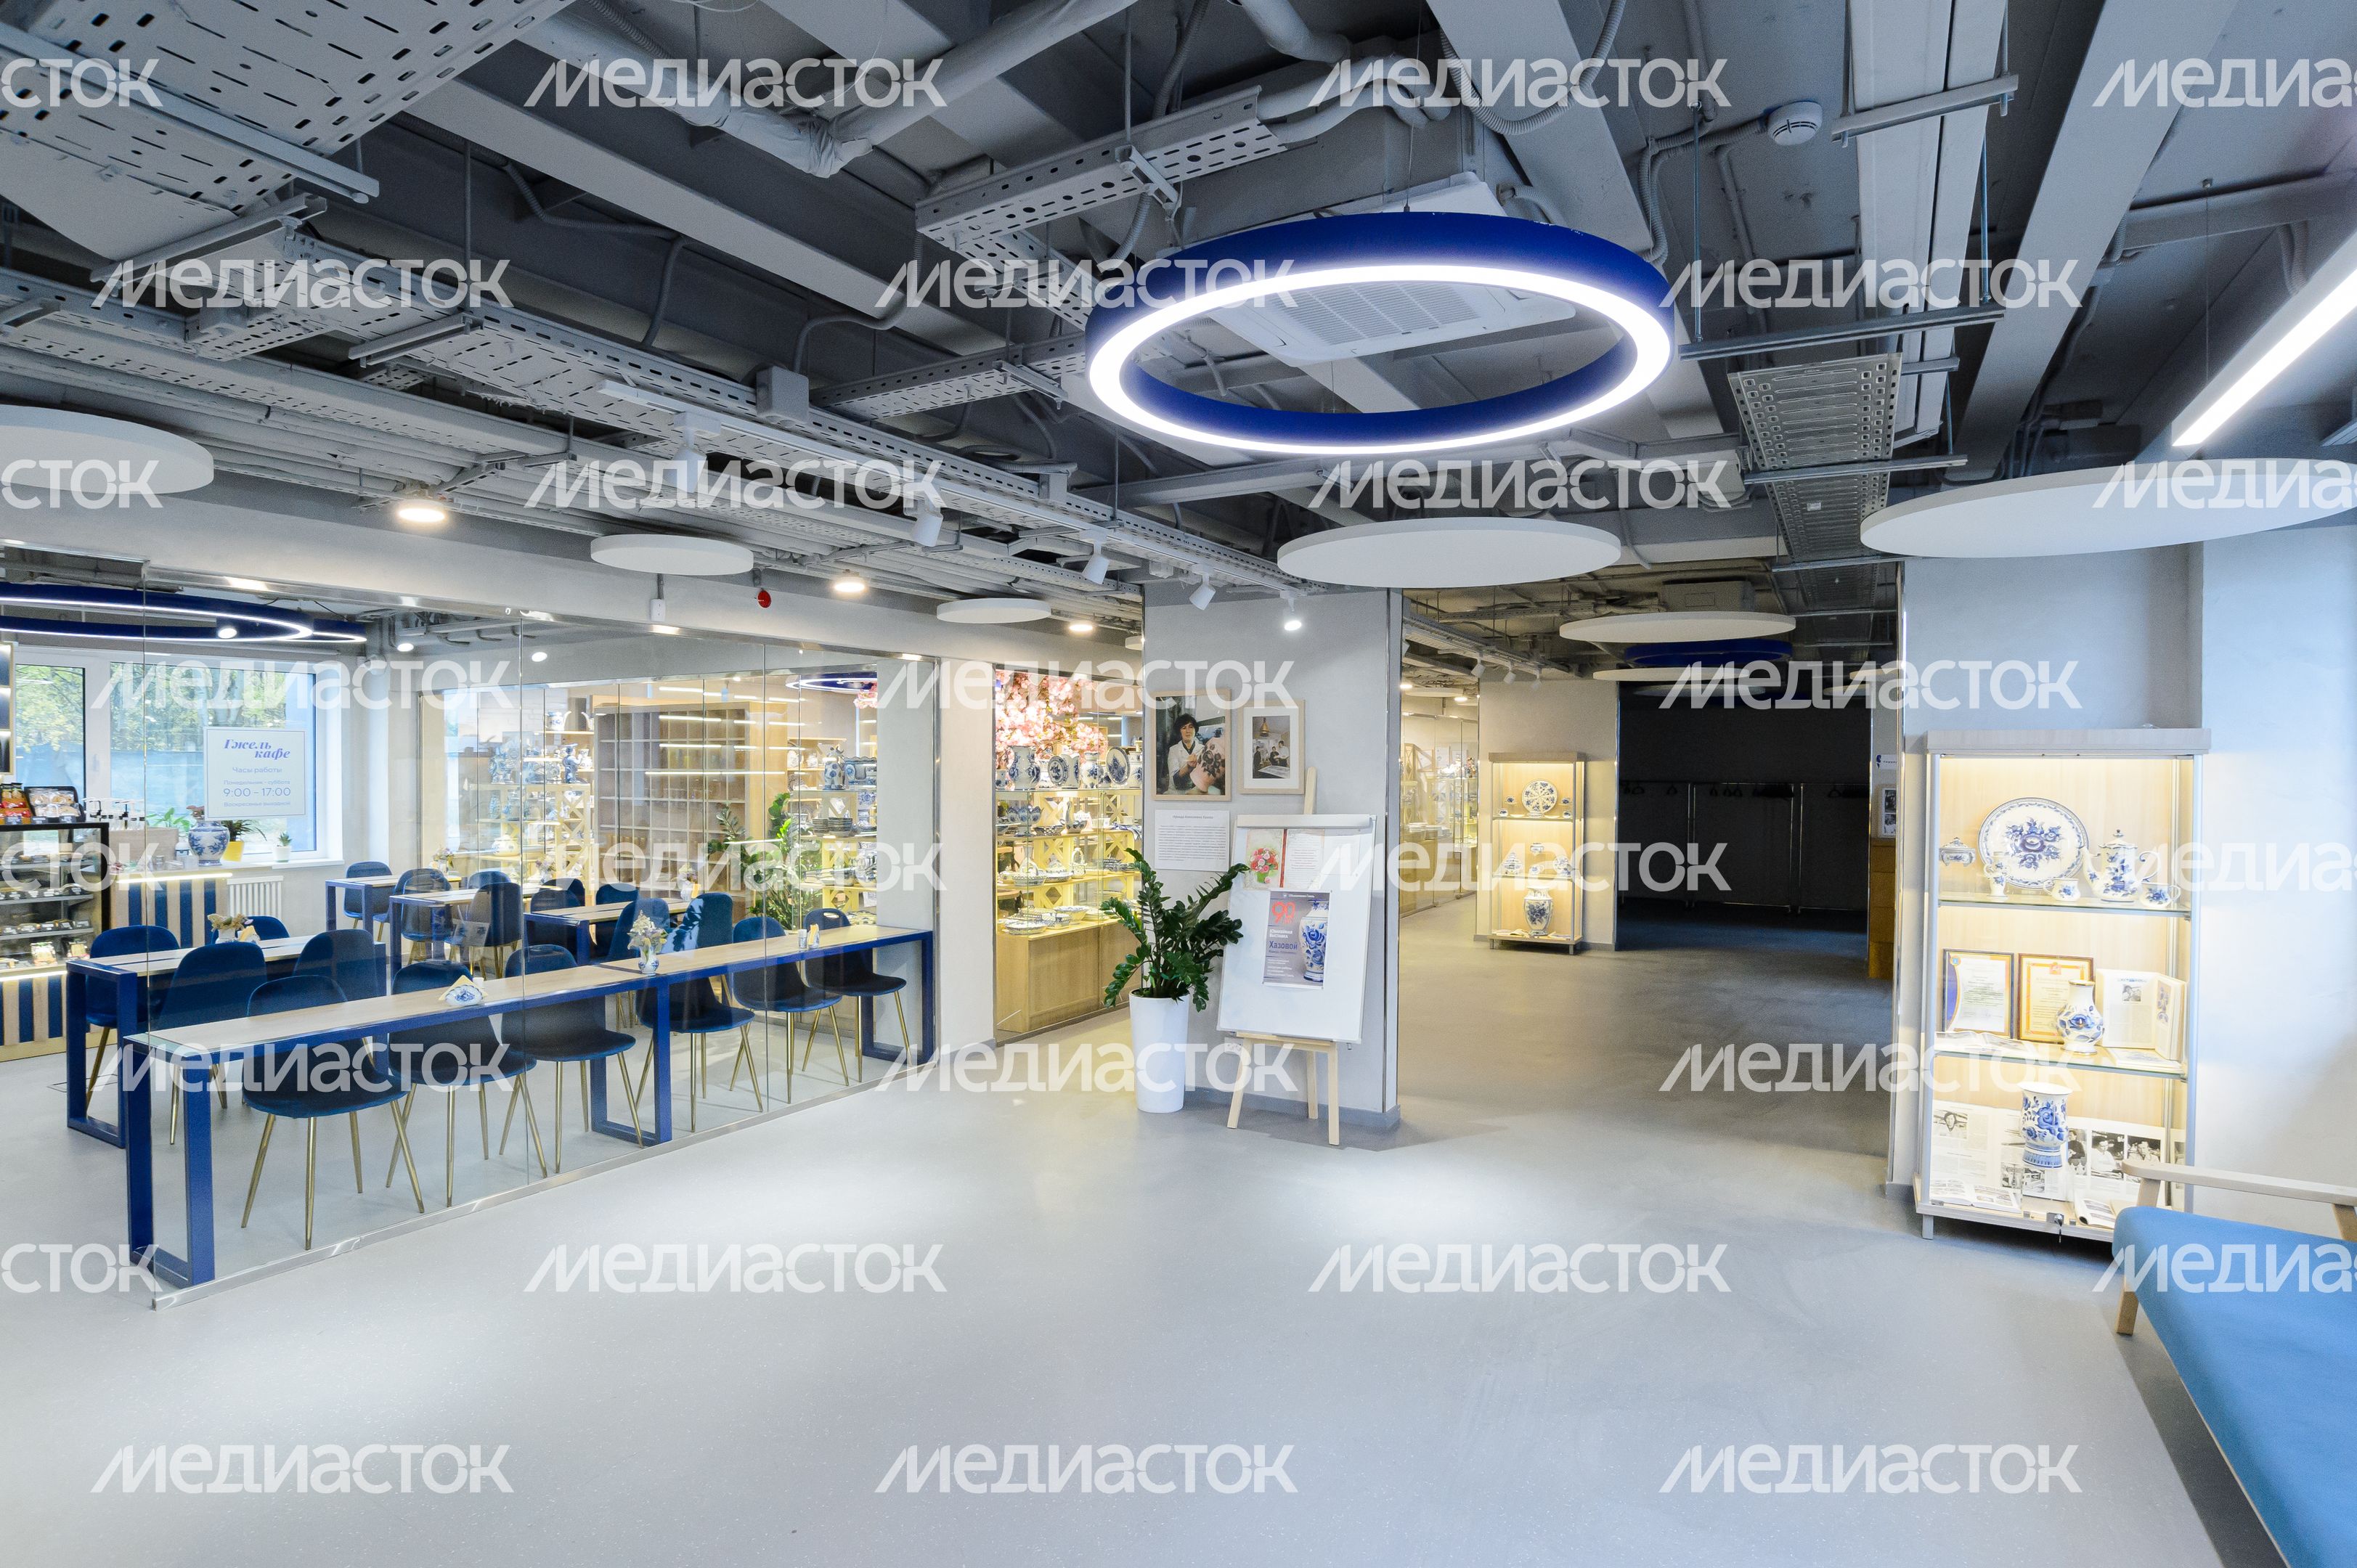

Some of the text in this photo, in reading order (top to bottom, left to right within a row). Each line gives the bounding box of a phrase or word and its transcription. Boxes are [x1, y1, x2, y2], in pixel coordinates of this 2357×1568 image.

[224, 739, 272, 749] Гжель
[254, 748, 290, 760] кафе
[224, 788, 251, 797] 9:00
[261, 787, 291, 796] 17:00
[1271, 901, 1296, 924] 90
[1269, 940, 1298, 950] Хазовой
